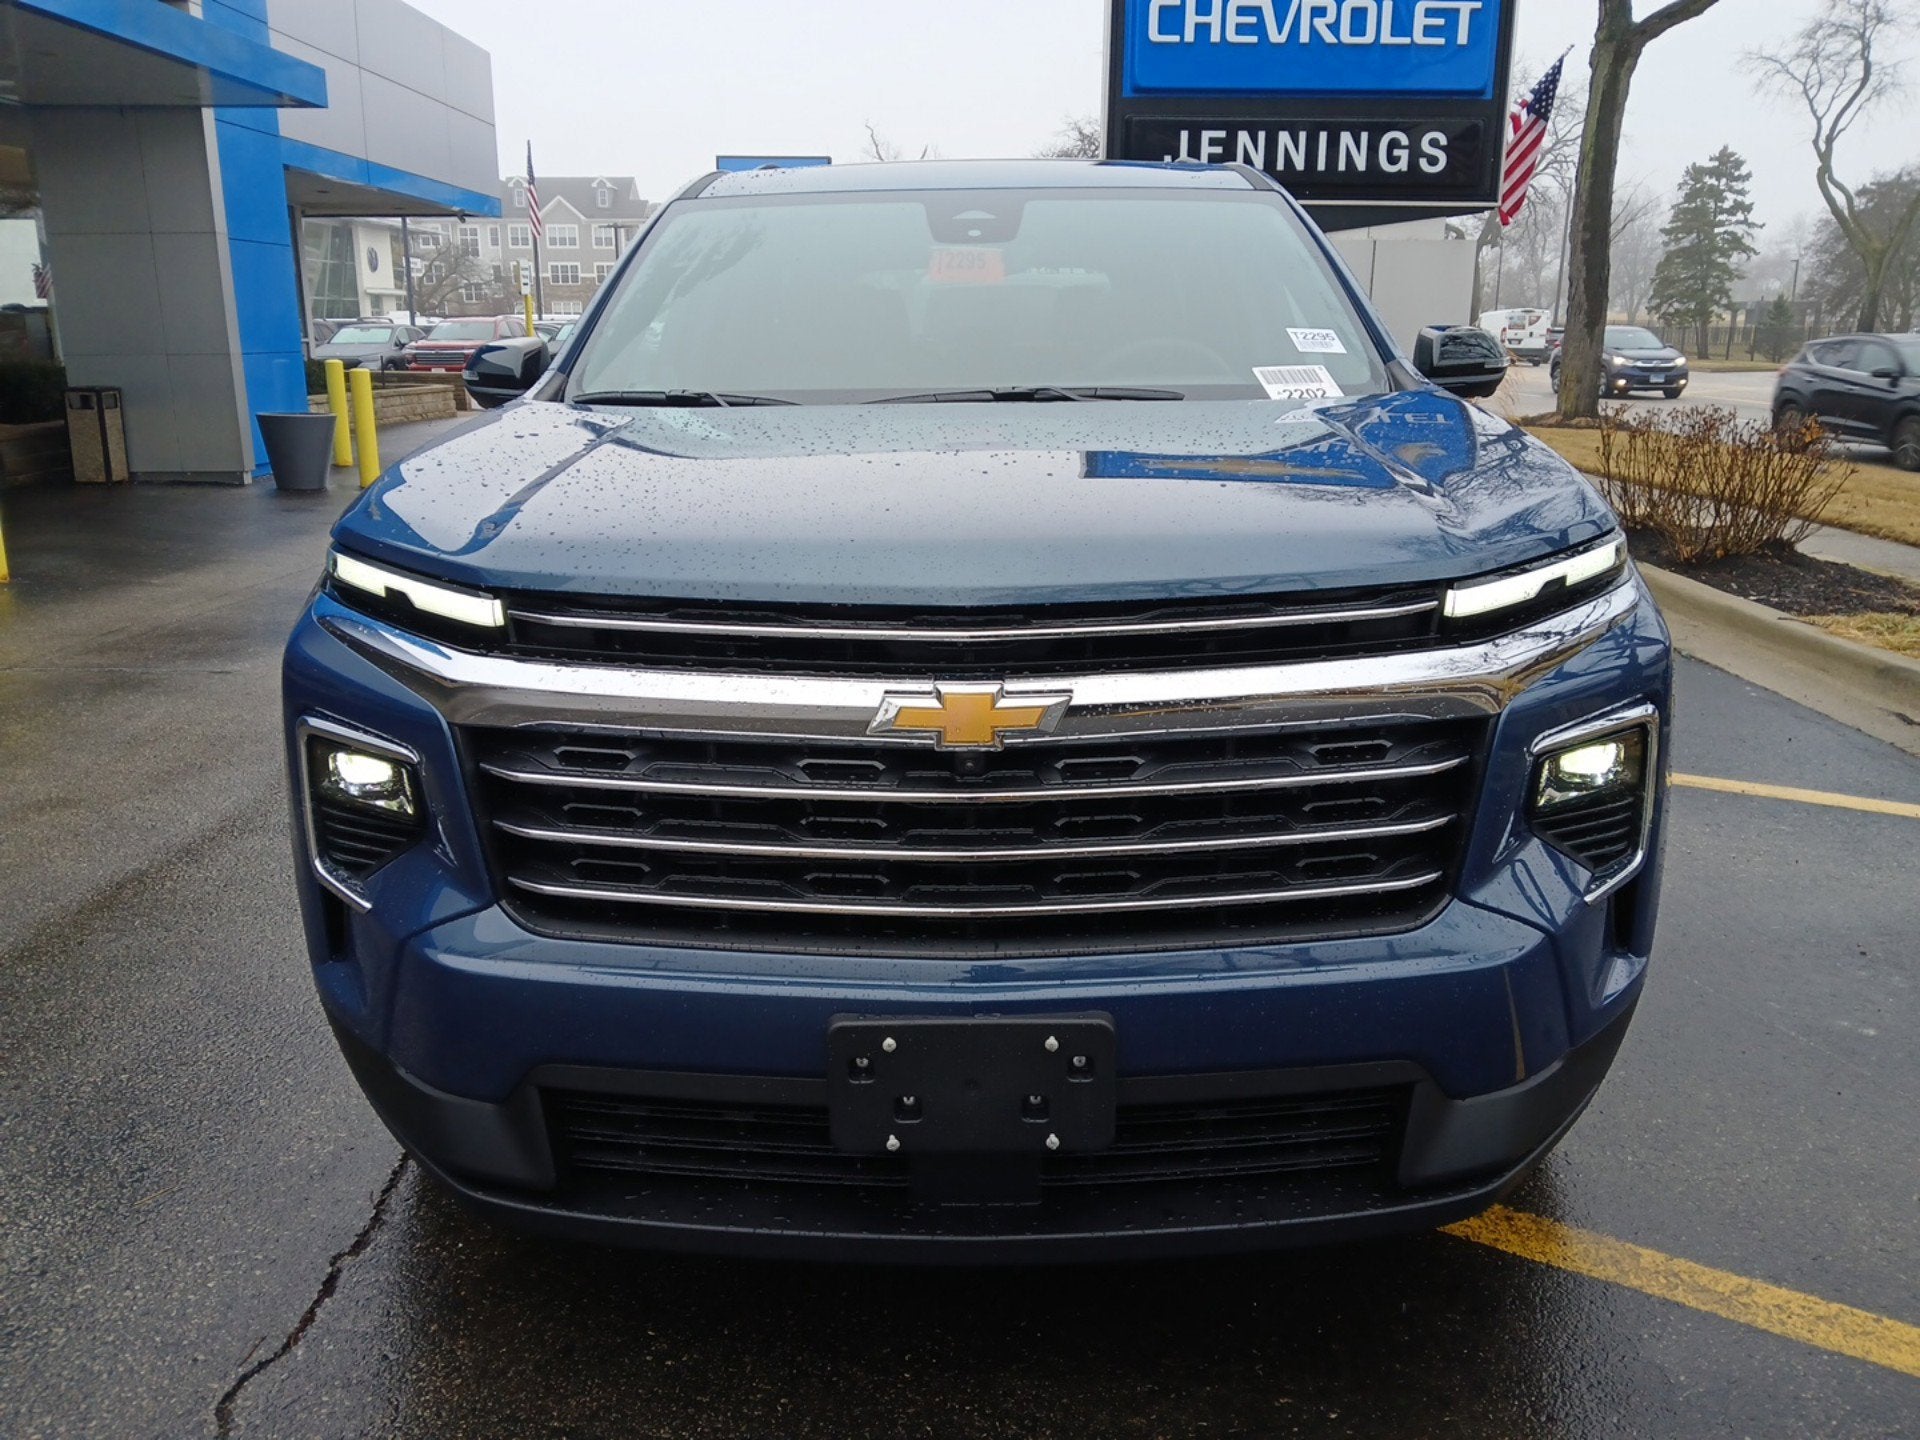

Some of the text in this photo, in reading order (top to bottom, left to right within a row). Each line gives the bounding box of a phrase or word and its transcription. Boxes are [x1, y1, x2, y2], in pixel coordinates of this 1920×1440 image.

[1148, 0, 1482, 45] CHEVROLET
[1163, 130, 1448, 174] JENNINGS
[1291, 331, 1336, 341] T2295
